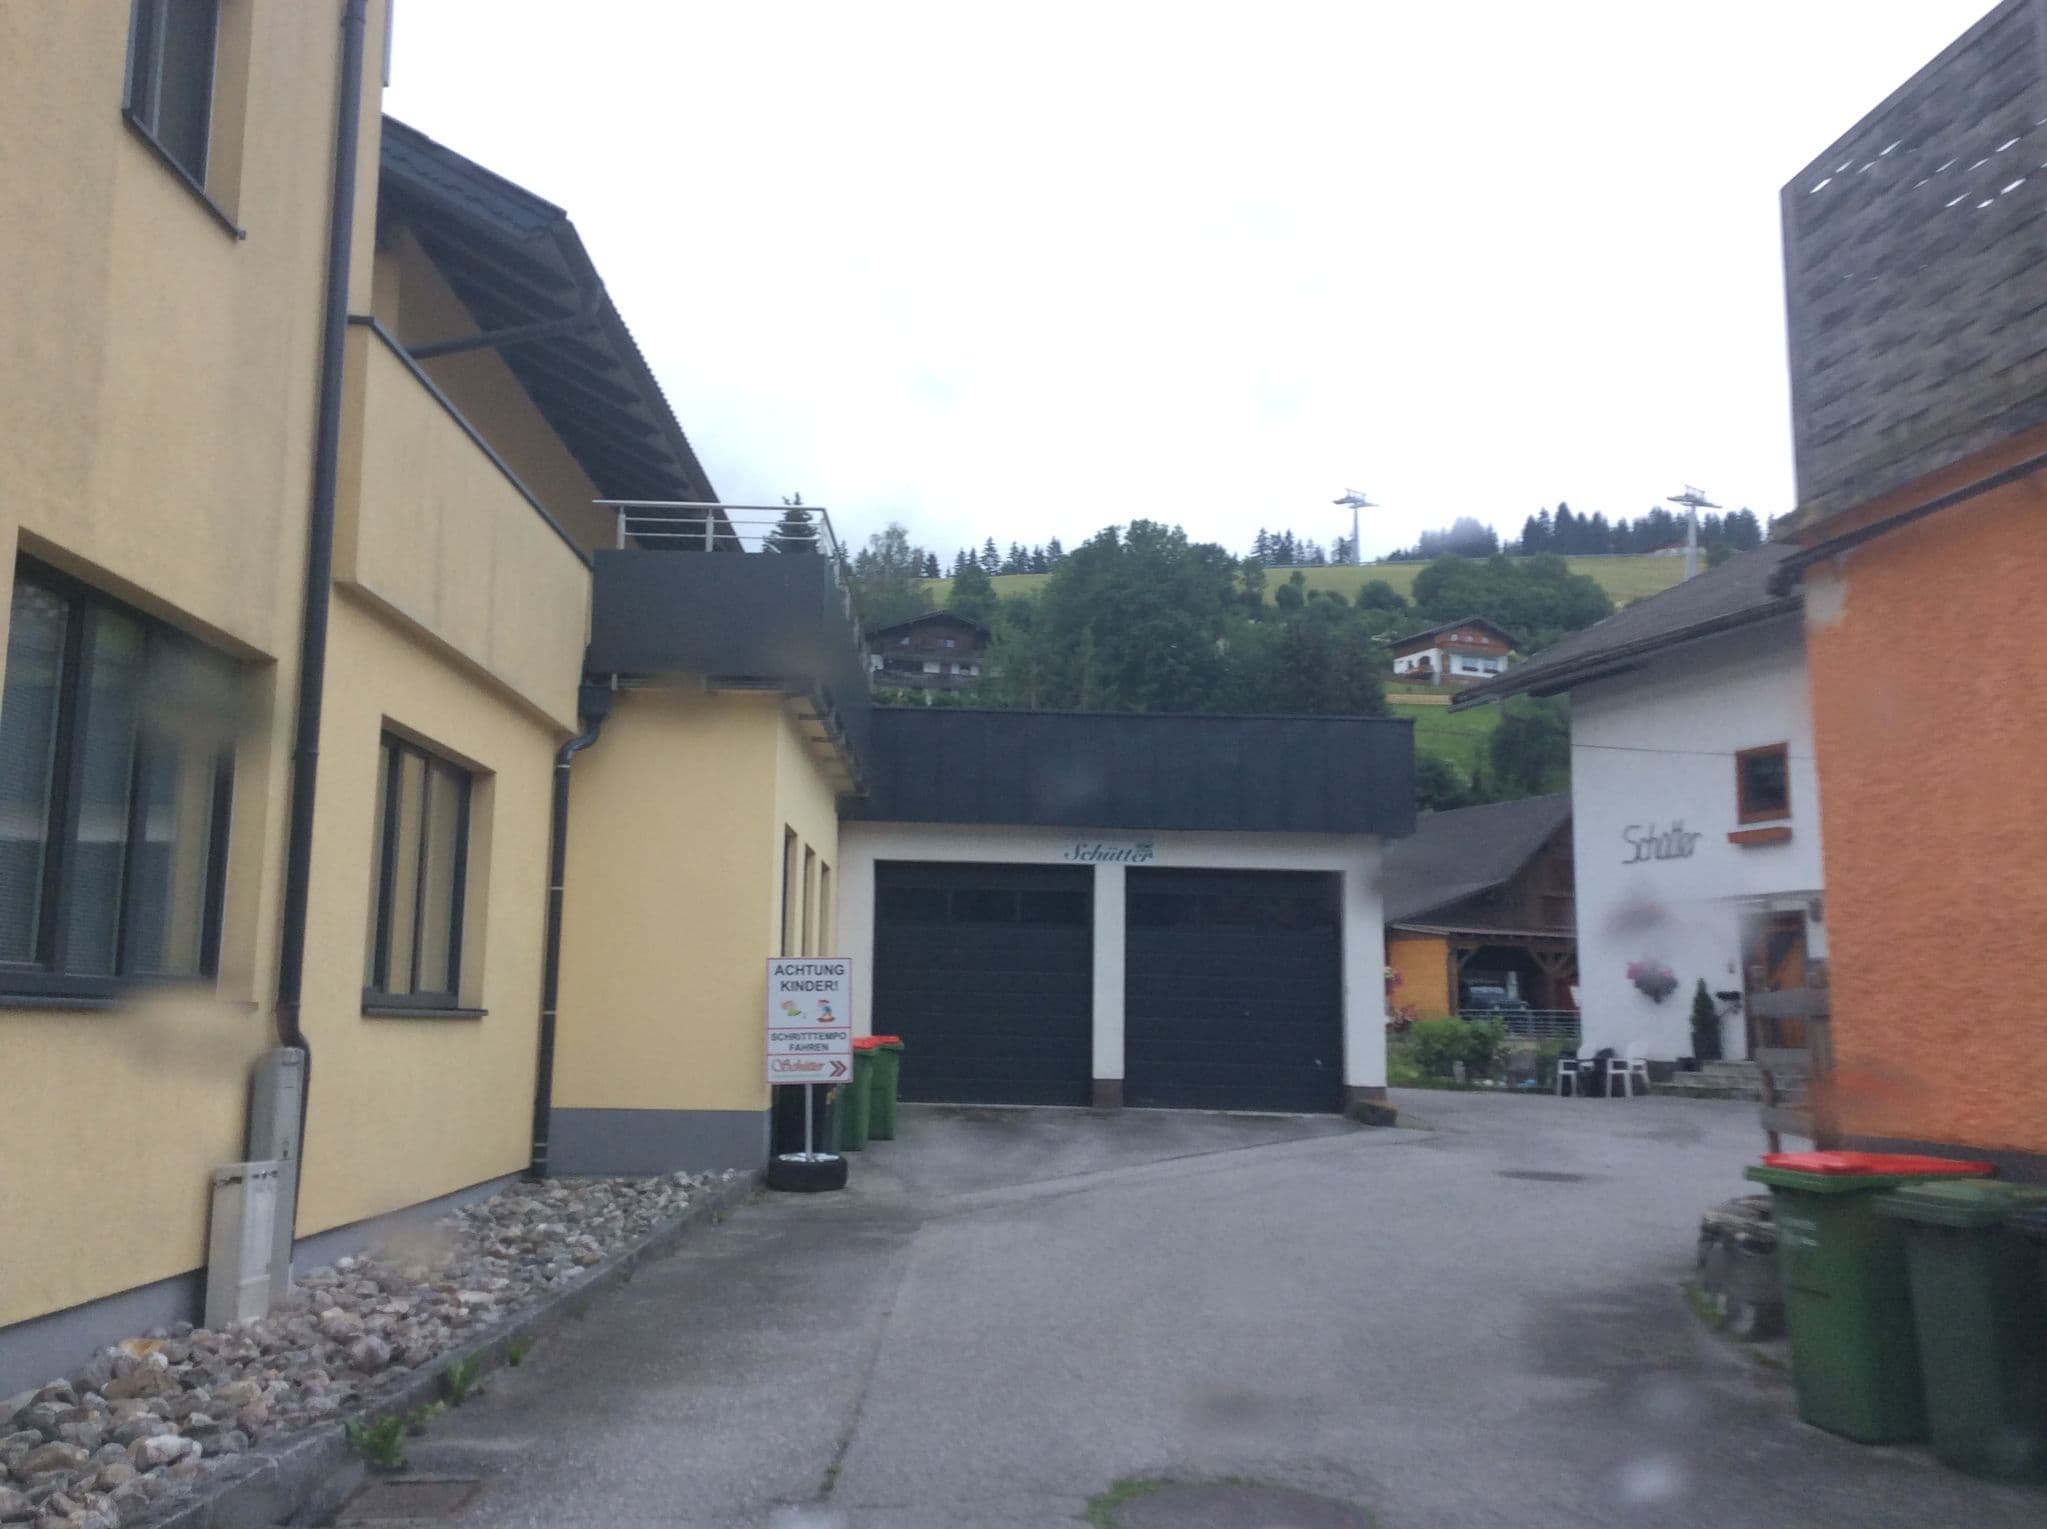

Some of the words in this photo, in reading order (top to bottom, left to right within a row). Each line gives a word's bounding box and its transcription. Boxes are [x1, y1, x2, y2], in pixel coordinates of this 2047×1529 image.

[774, 964, 845, 976] ACHTUNG
[780, 980, 839, 992] KINDER!
[789, 1043, 829, 1051] FAHREN
